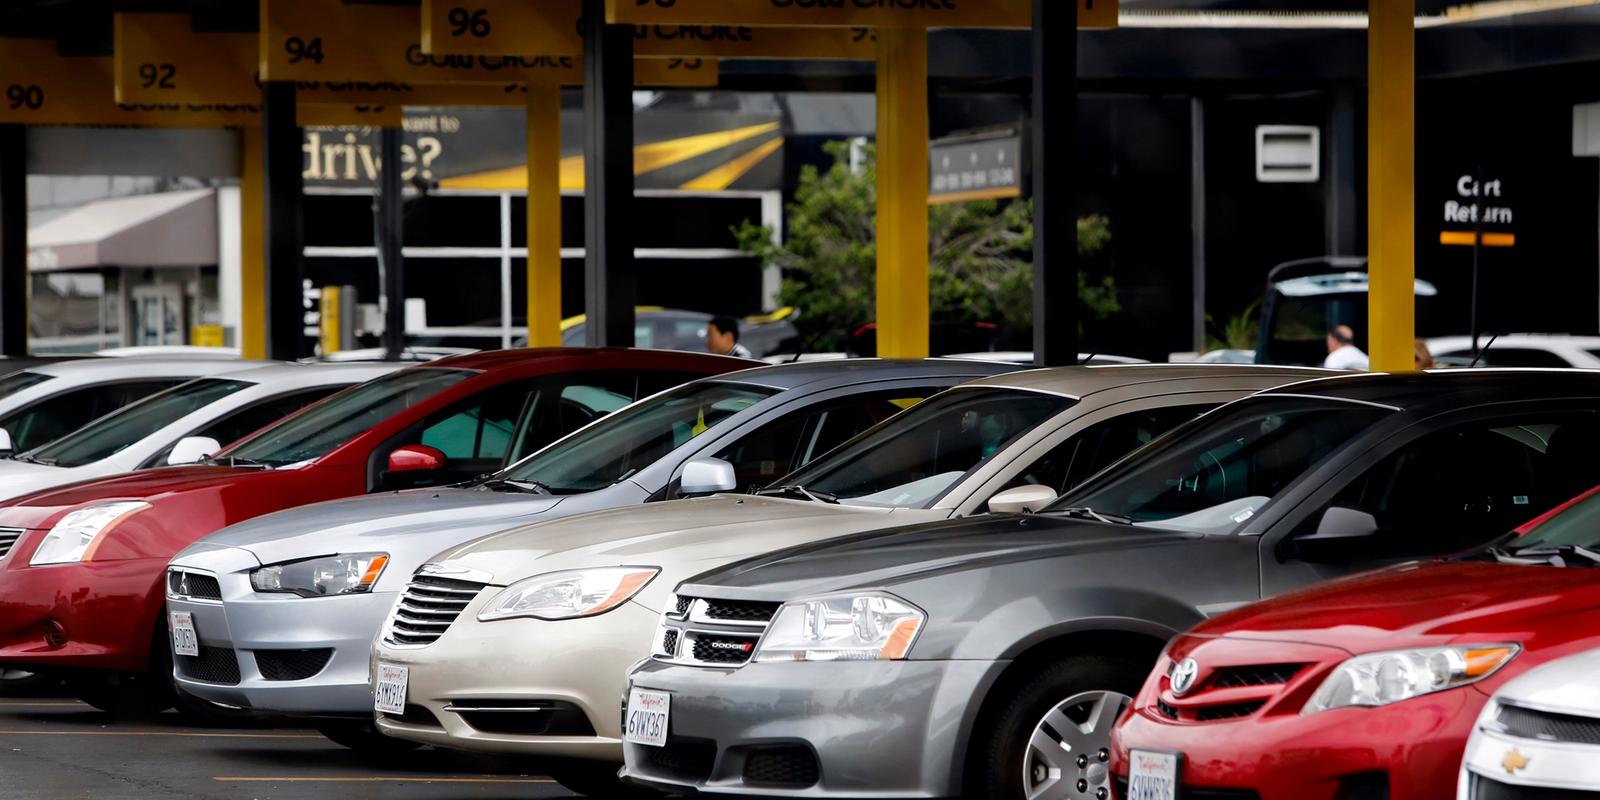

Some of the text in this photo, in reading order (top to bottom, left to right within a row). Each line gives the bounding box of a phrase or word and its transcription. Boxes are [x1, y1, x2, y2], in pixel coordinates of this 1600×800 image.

[448, 8, 491, 38] 96
[285, 37, 324, 64] 94
[139, 63, 177, 89] 92
[6, 84, 44, 110] 90
[711, 642, 745, 650] DODGE
[629, 710, 666, 738] 6VWY367
